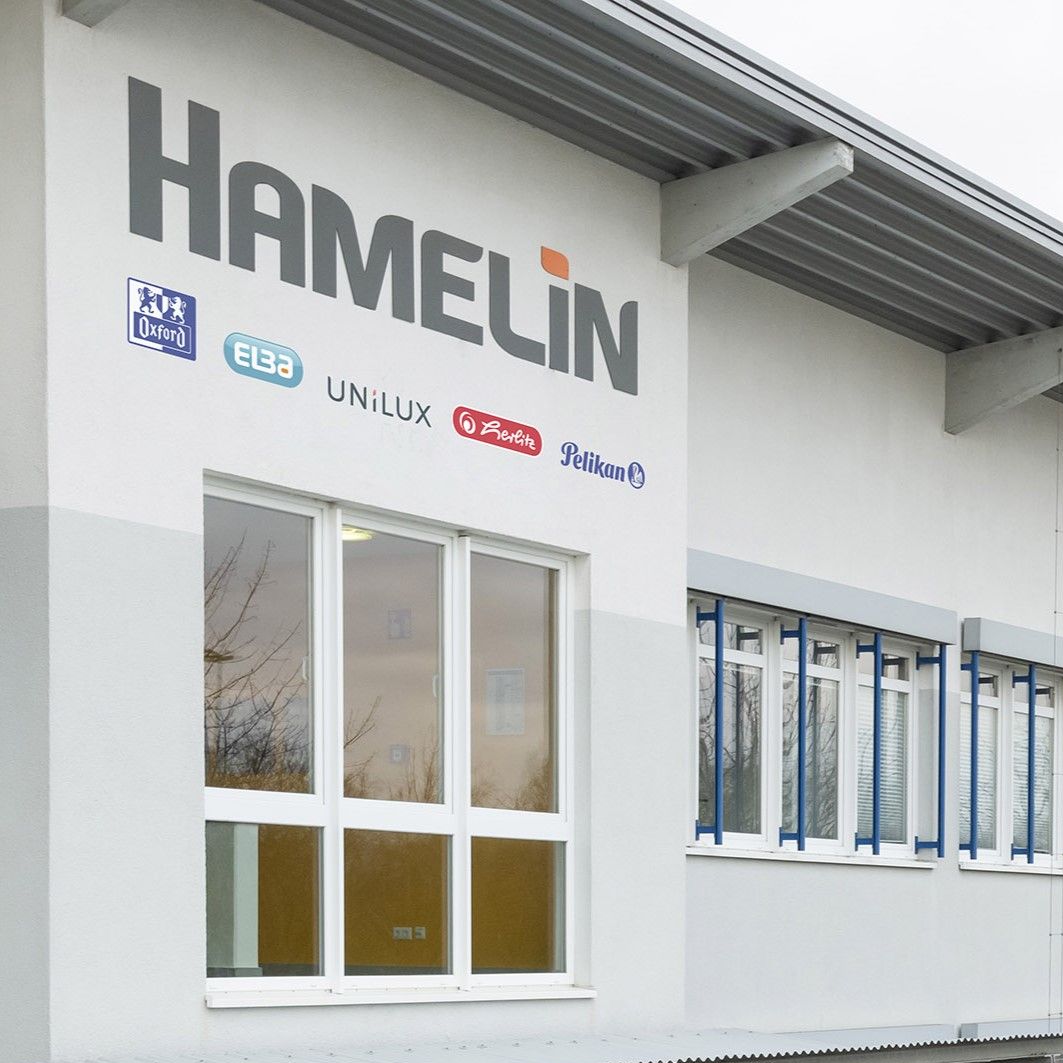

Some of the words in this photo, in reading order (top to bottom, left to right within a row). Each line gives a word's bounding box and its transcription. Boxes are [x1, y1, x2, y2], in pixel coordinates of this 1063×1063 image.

[128, 76, 638, 396] HAMELIN
[139, 316, 186, 348] Oxford
[327, 376, 432, 427] UNILUX
[561, 441, 626, 483] Pelikan
